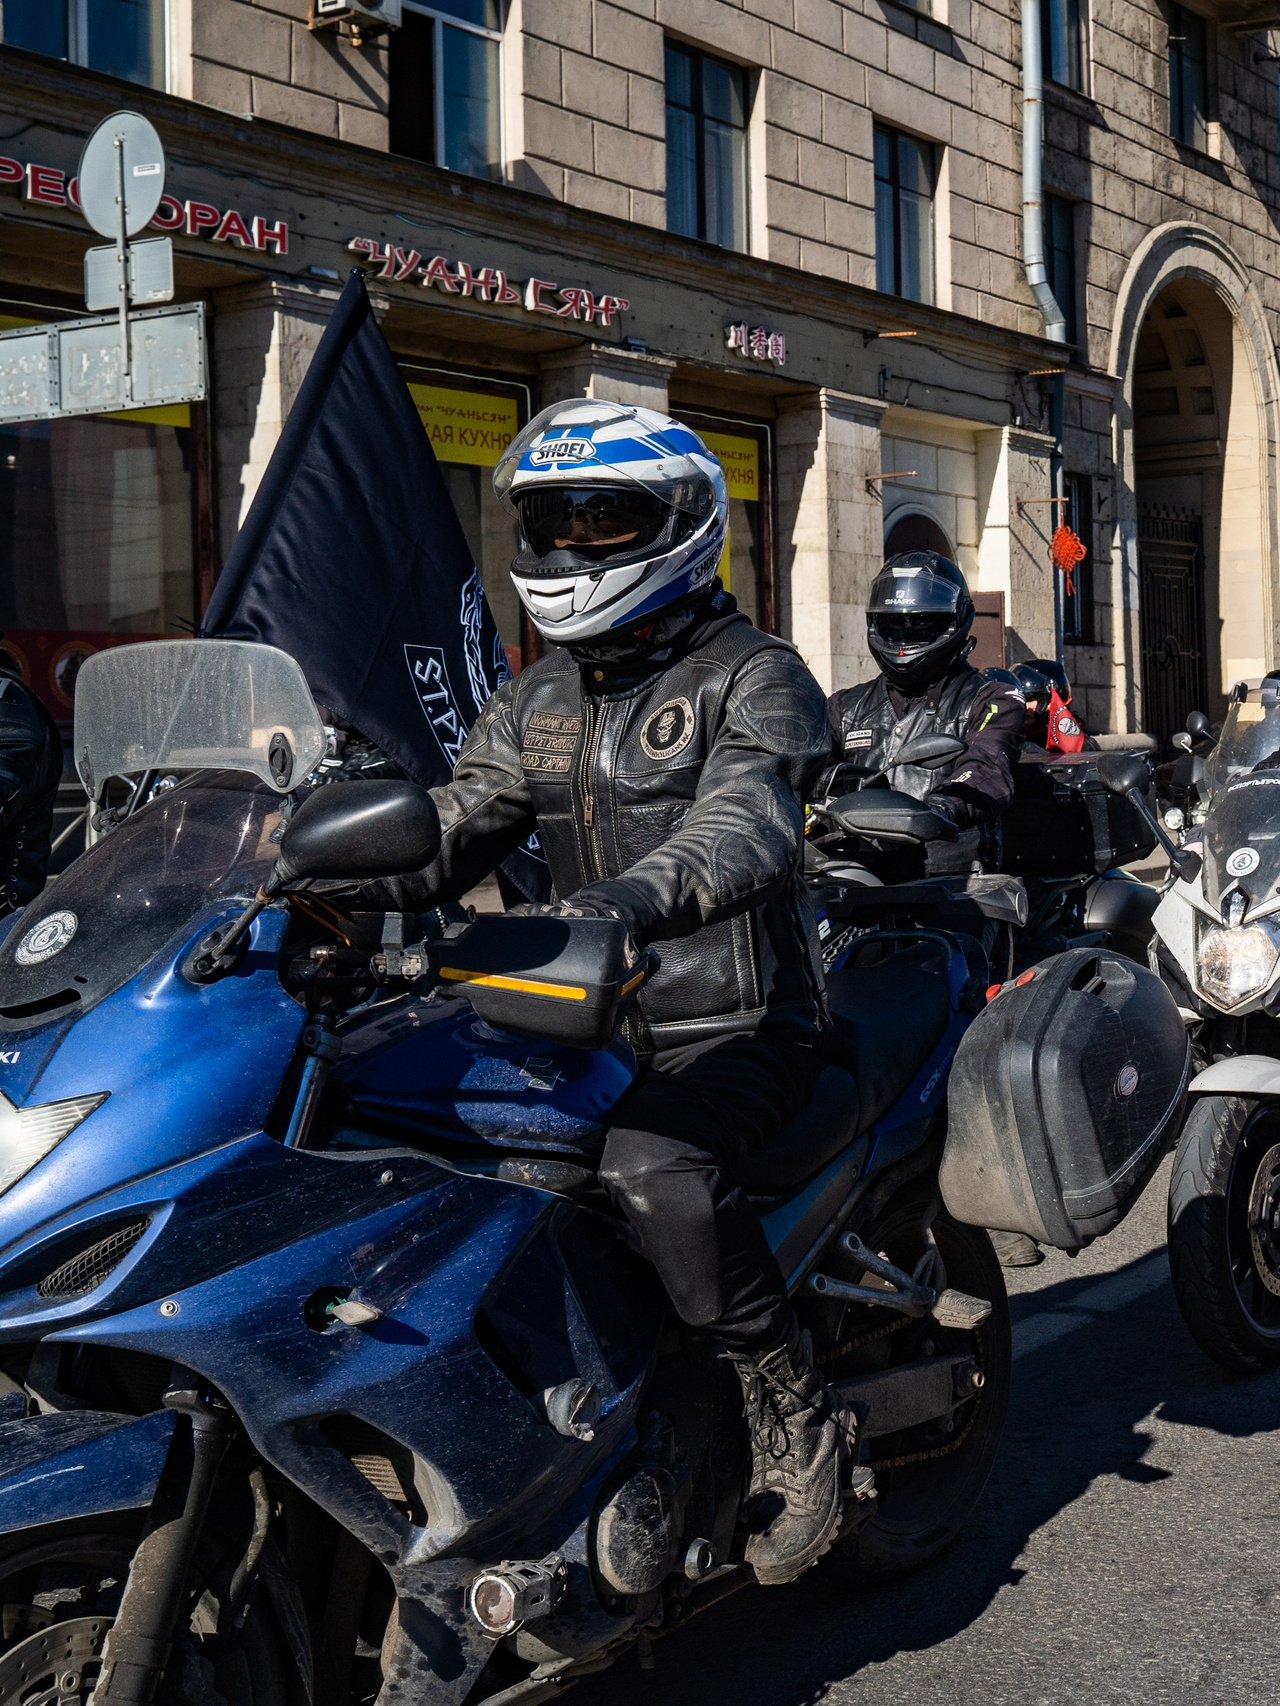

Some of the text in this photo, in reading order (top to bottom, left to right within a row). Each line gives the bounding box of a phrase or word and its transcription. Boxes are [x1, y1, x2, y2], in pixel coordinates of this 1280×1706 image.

[0, 157, 288, 254] РЕОРАН
[458, 426, 511, 451] КУХНЯ
[538, 441, 586, 461] SHOEI
[725, 465, 755, 485] УХНЯ
